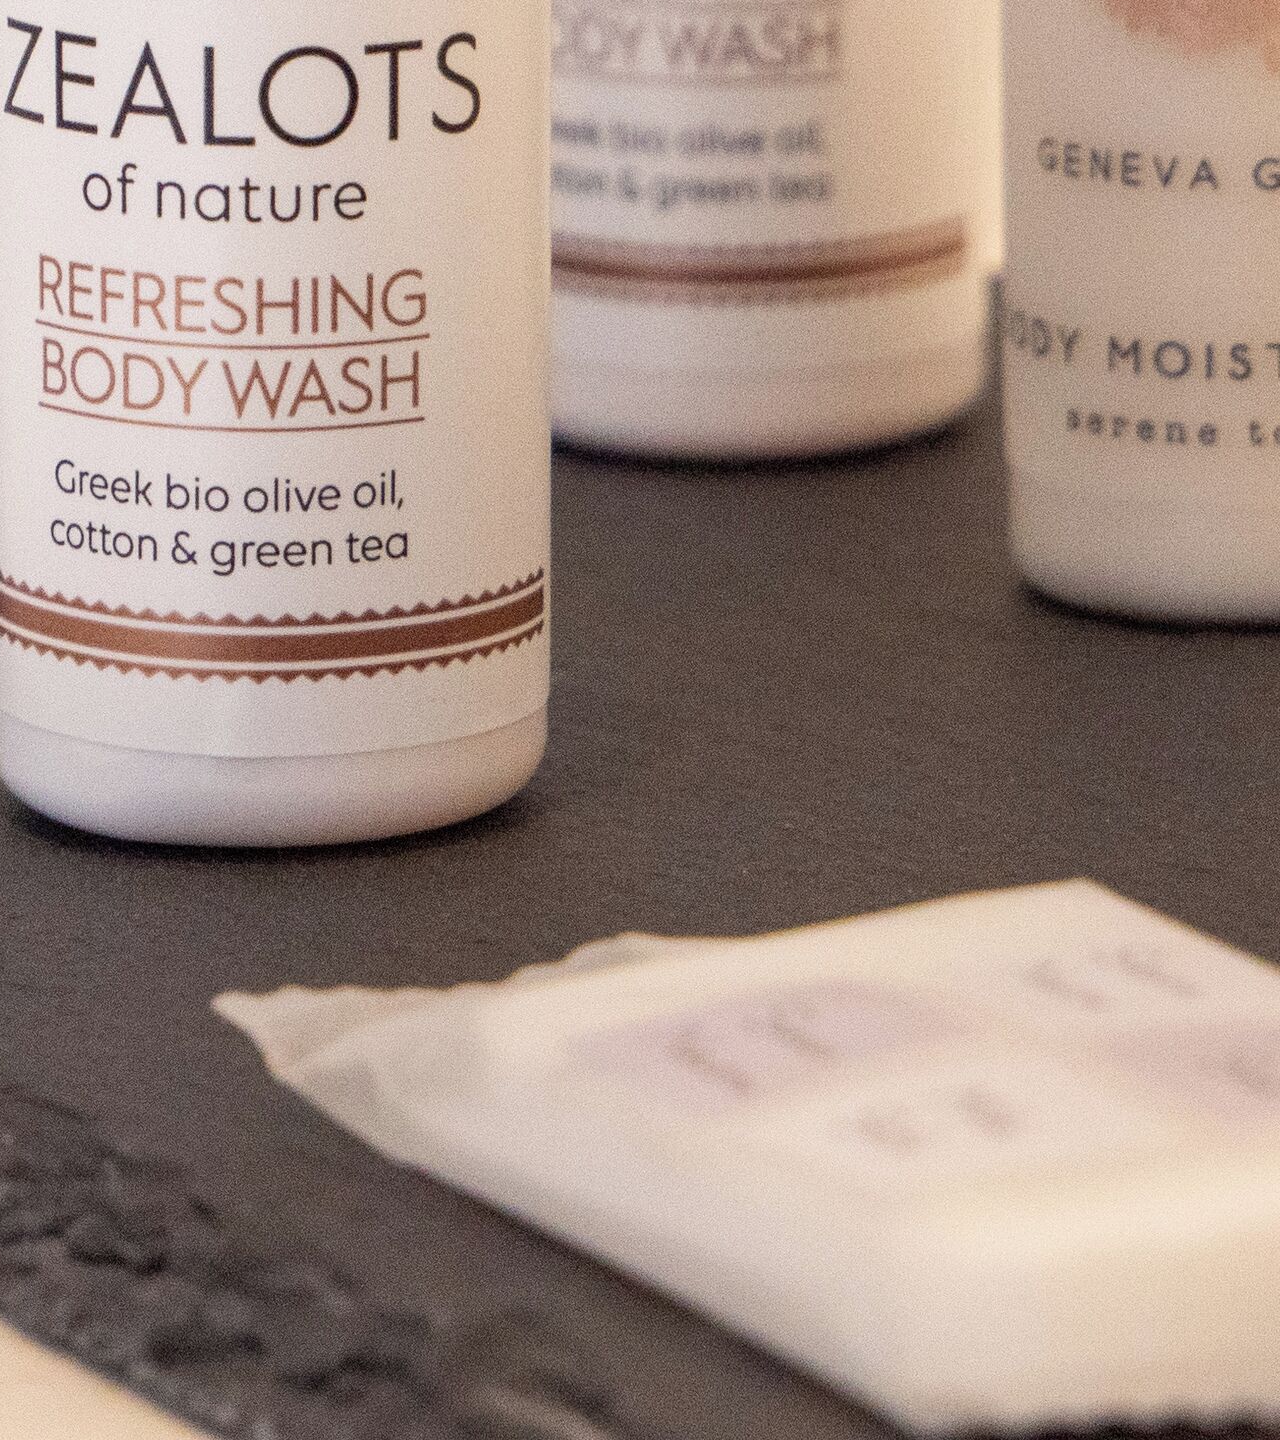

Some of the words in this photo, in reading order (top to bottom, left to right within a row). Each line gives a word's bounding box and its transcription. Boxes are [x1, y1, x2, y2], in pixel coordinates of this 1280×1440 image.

[3, 16, 482, 148] ZEALOTS
[81, 161, 138, 215] of
[156, 173, 369, 223] nature
[1036, 136, 1220, 191] GENEVA
[37, 252, 428, 336] REFRESHING
[1006, 310, 1081, 363] ODY
[41, 336, 210, 417] BODY
[221, 351, 421, 421] WASH
[1066, 407, 1218, 448] serene
[54, 458, 153, 508] Greek
[165, 472, 231, 512] bio
[242, 476, 341, 513] olive
[352, 468, 405, 511] oil,
[50, 518, 159, 561] cotton
[170, 530, 199, 565] &
[209, 539, 333, 577] green
[345, 529, 409, 563] tea
